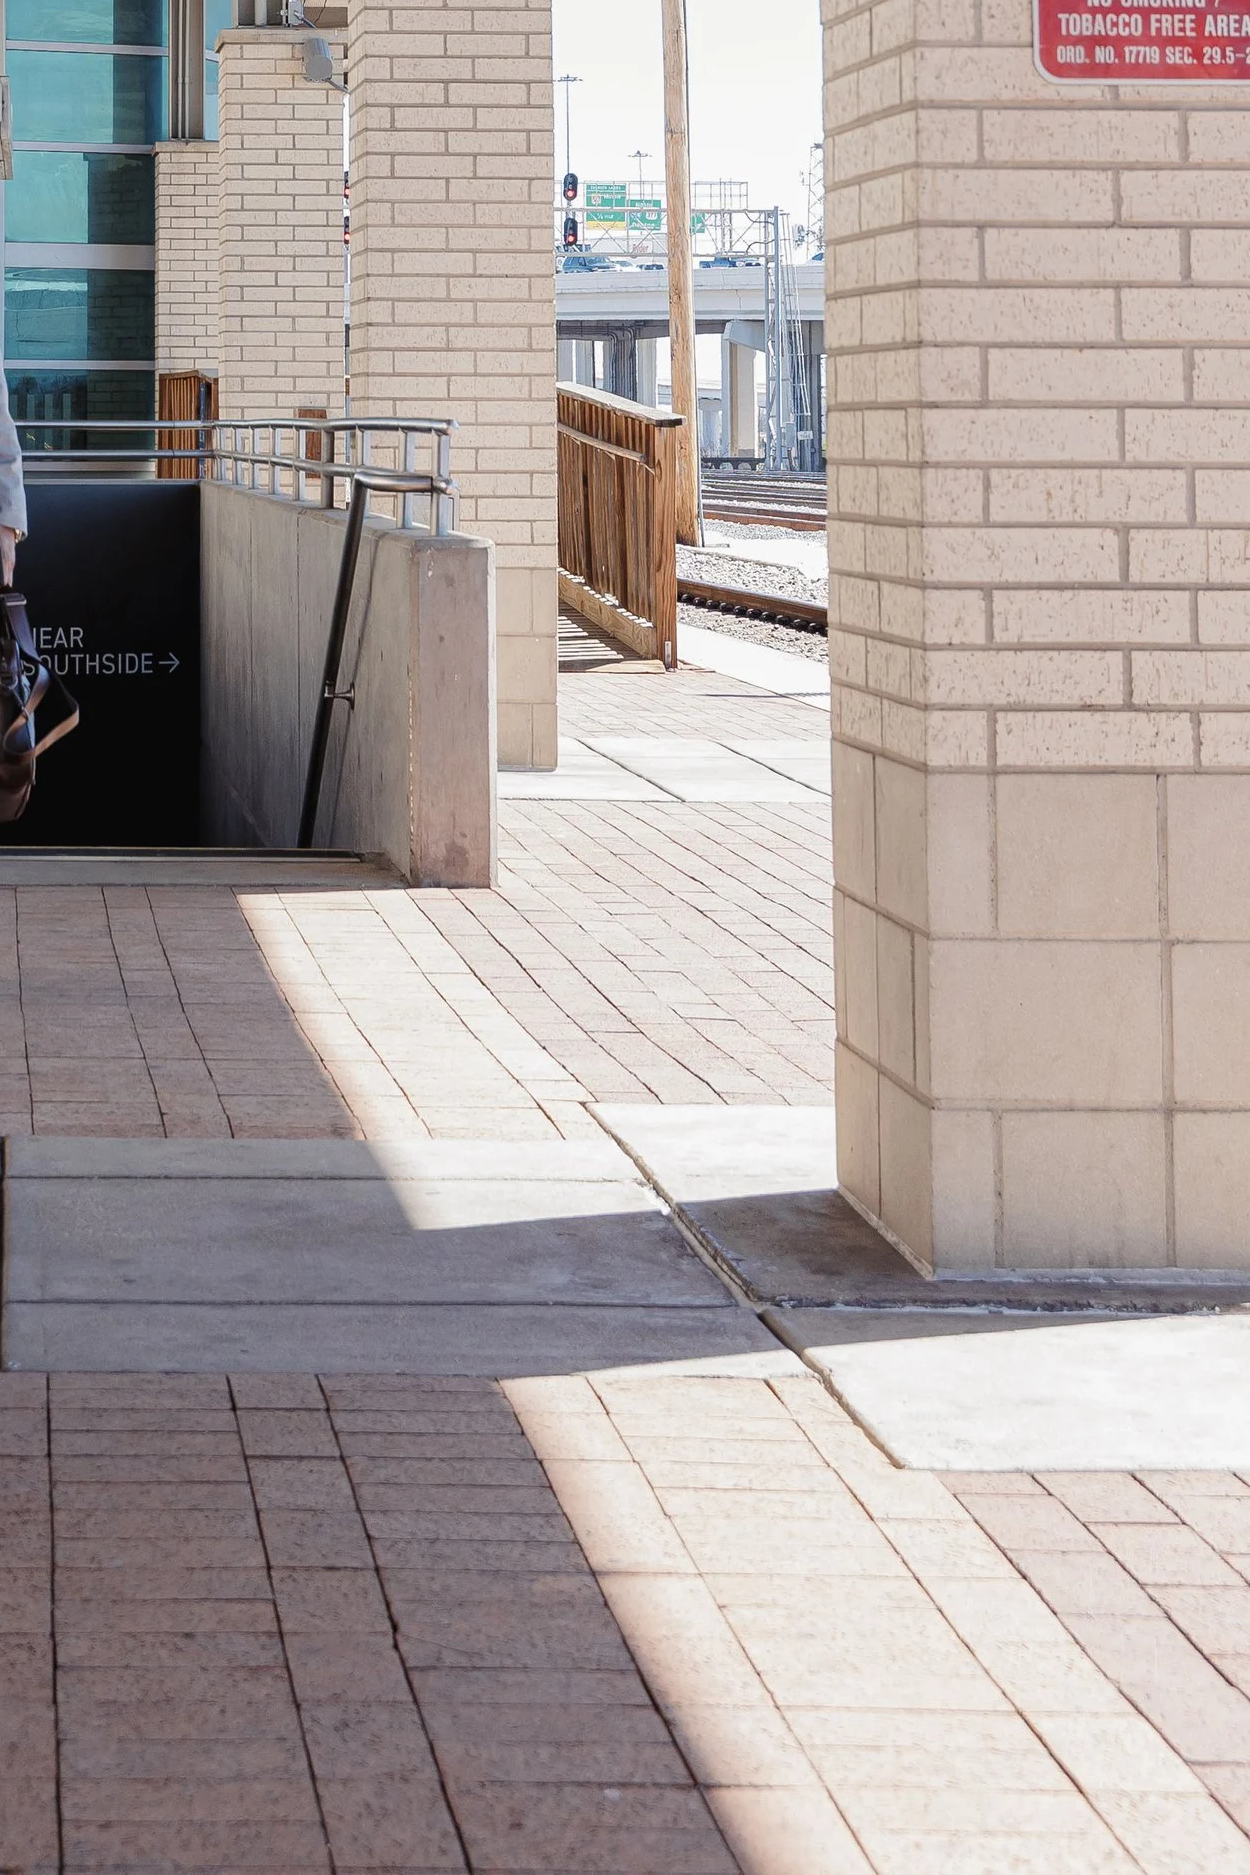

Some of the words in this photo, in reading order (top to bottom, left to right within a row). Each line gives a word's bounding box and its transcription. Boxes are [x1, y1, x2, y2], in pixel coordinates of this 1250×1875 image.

[1057, 13, 1143, 37] TOBACCO
[1150, 13, 1197, 37] FREE
[1204, 14, 1250, 37] AREA
[1056, 45, 1090, 64] ORD.
[1095, 45, 1119, 64] NO.
[1124, 45, 1160, 64] 17719
[1165, 46, 1198, 64] SEC.
